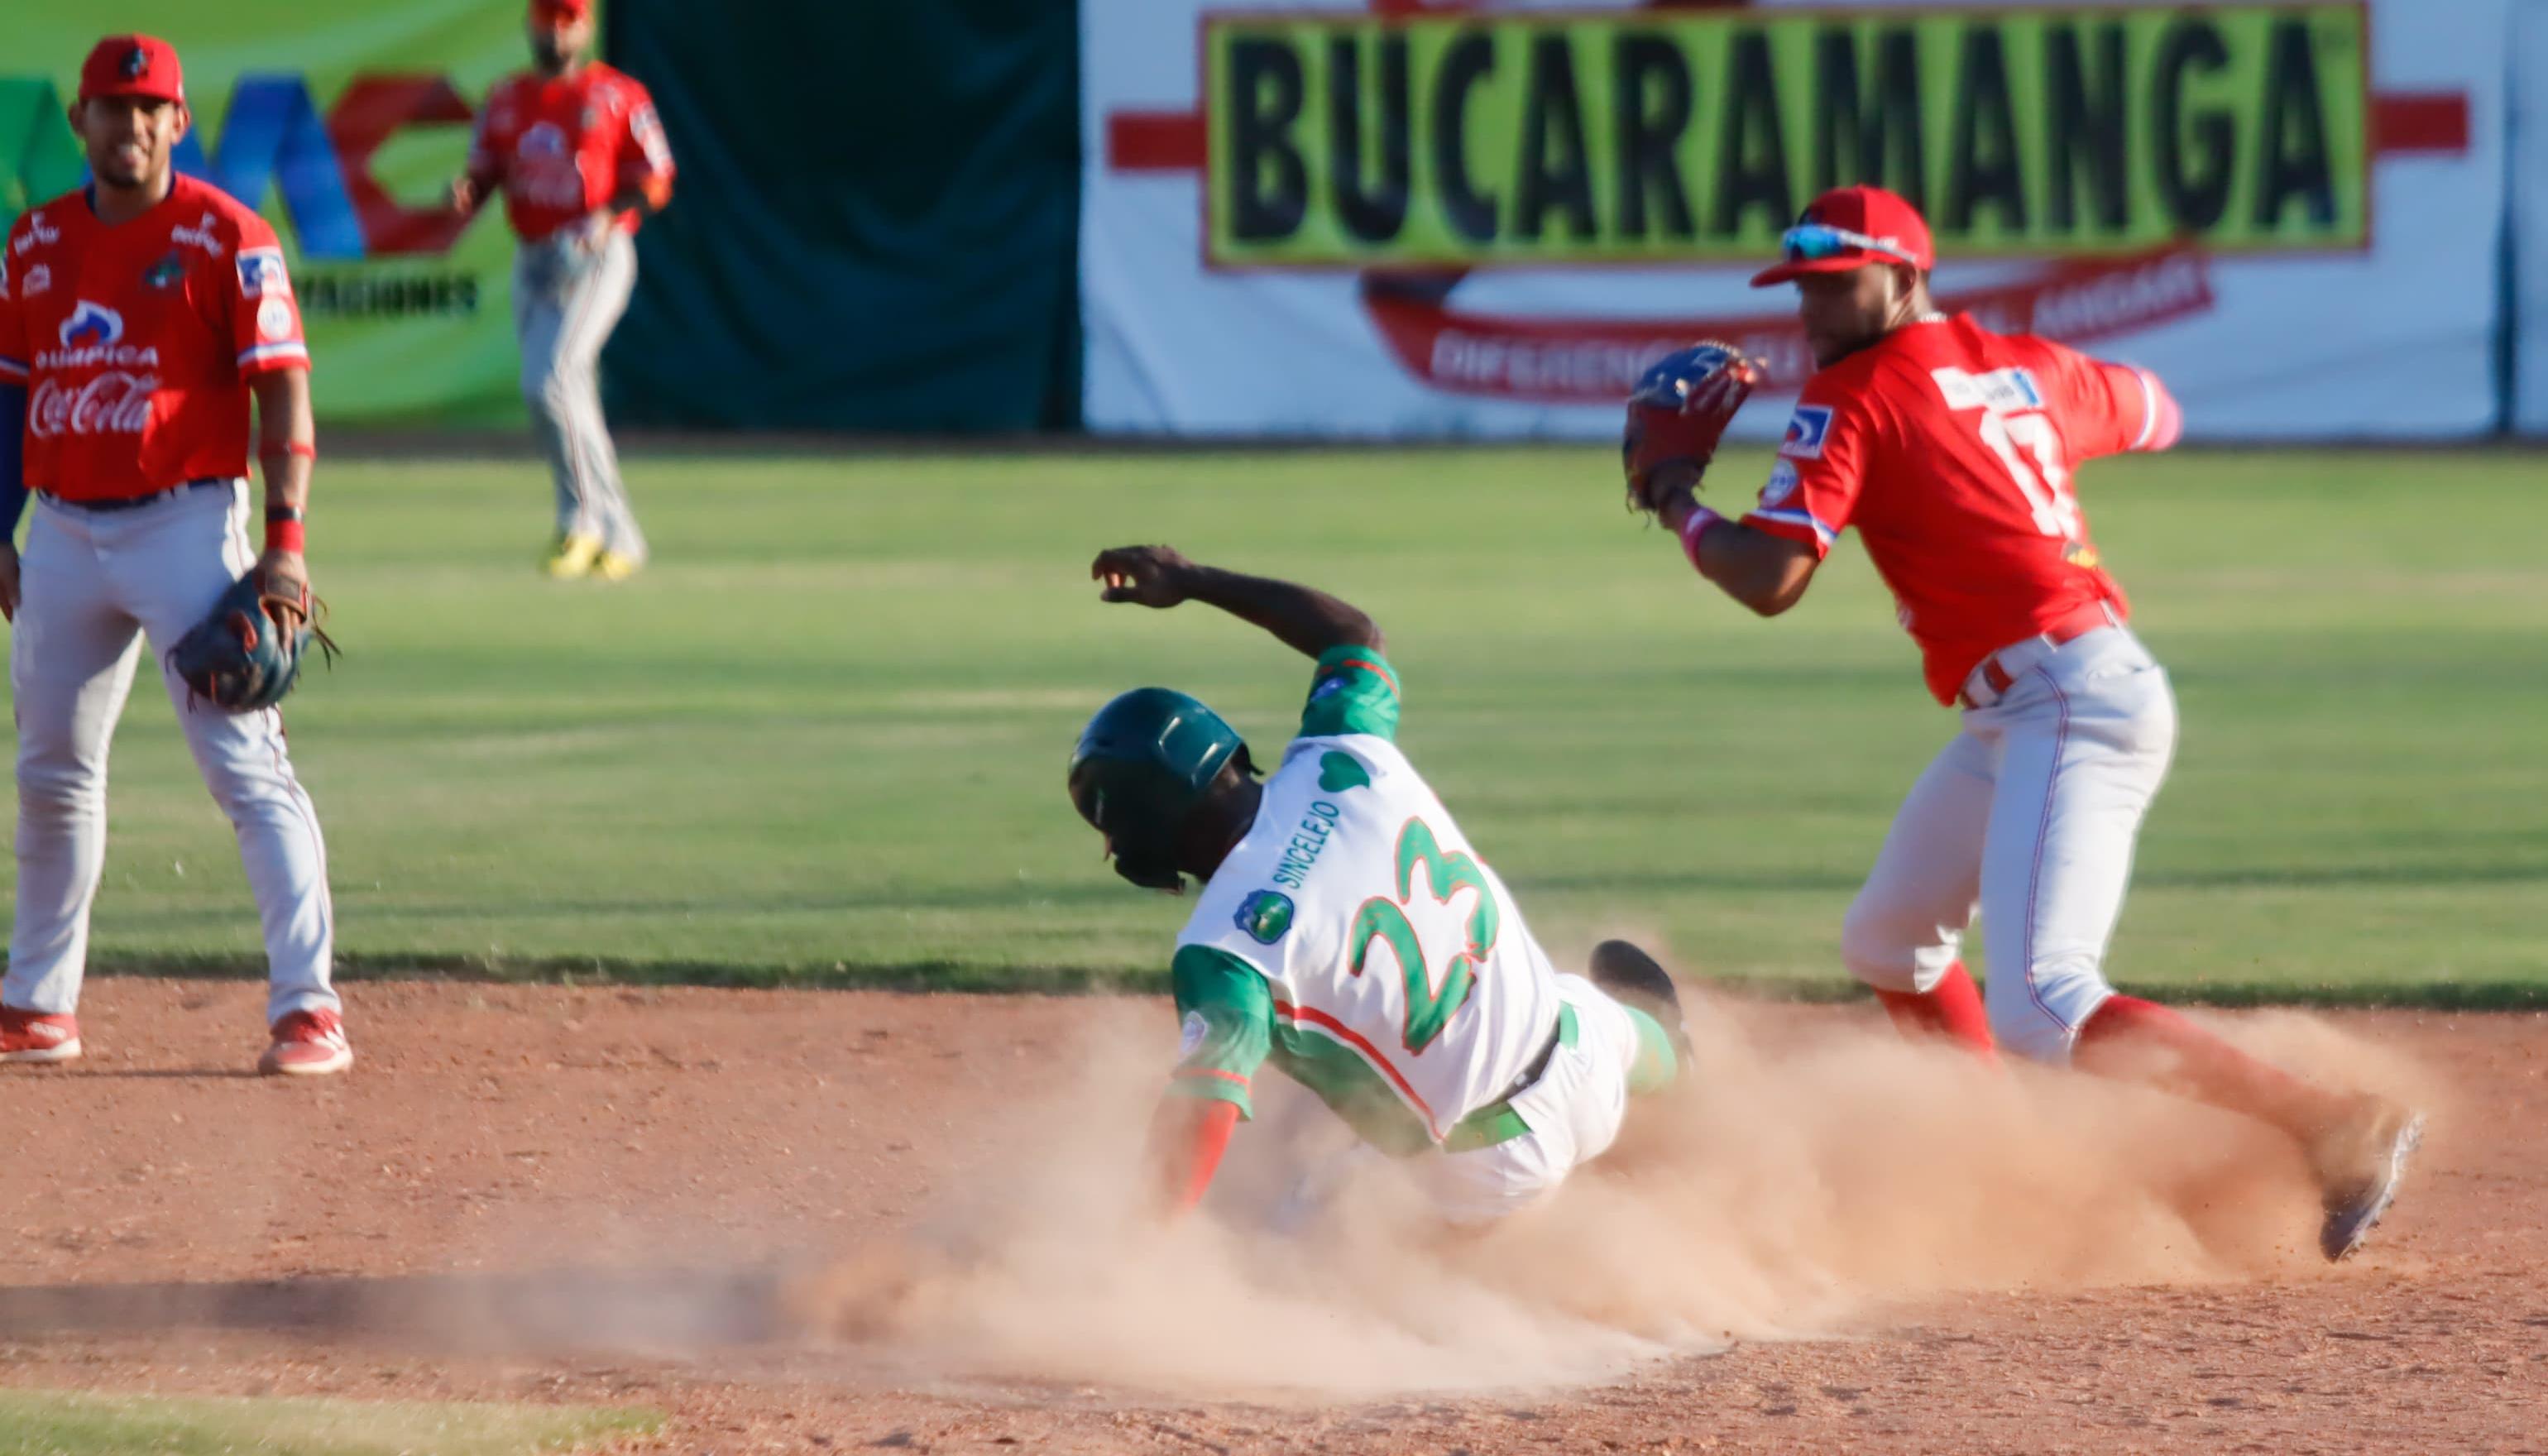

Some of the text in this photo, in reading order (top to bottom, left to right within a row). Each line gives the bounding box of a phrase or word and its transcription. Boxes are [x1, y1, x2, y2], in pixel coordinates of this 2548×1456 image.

[1228, 18, 2335, 245] BUCARAMANGA
[1272, 800, 1340, 889] SINCELEJO
[1348, 816, 1499, 1056] 23
